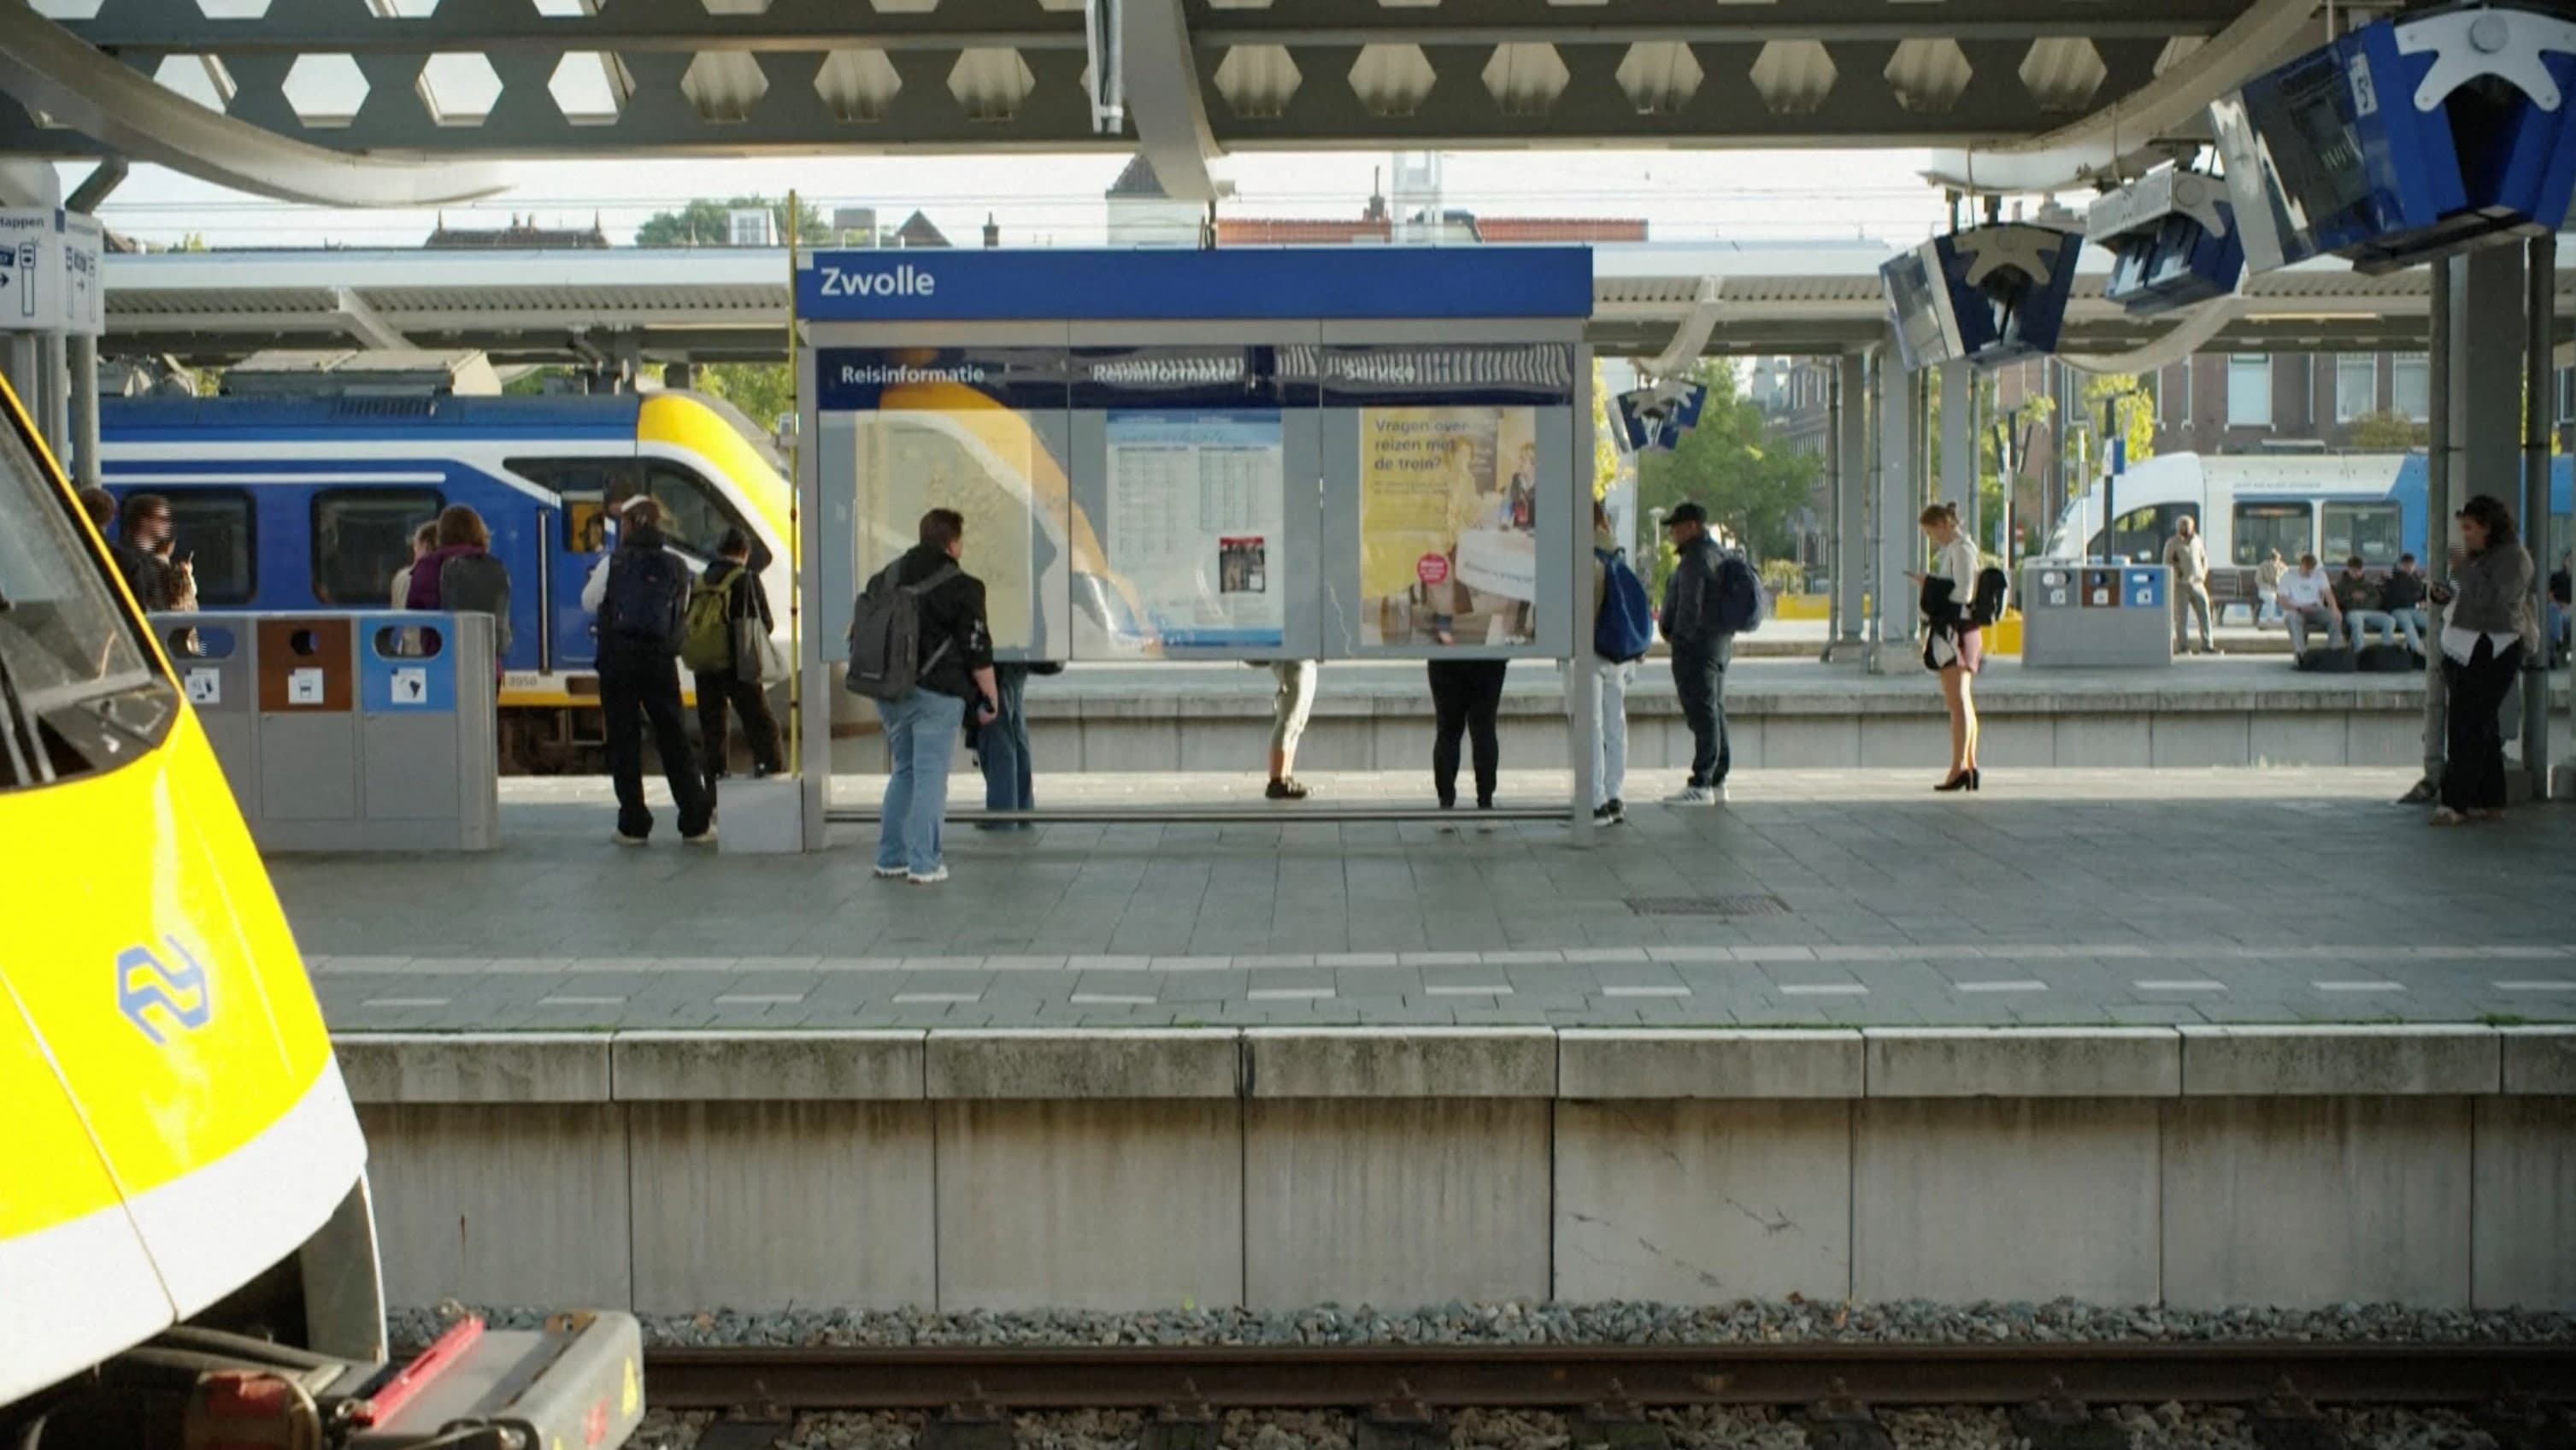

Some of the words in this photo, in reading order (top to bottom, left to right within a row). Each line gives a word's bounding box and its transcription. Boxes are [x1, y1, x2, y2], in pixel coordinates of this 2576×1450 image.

[820, 265, 935, 295] Zwolle
[842, 363, 985, 384] Reisinformatie
[1374, 418, 1429, 434] Vragen
[1434, 421, 1467, 432] over
[1374, 437, 1421, 451] reizen
[1373, 455, 1394, 470] de
